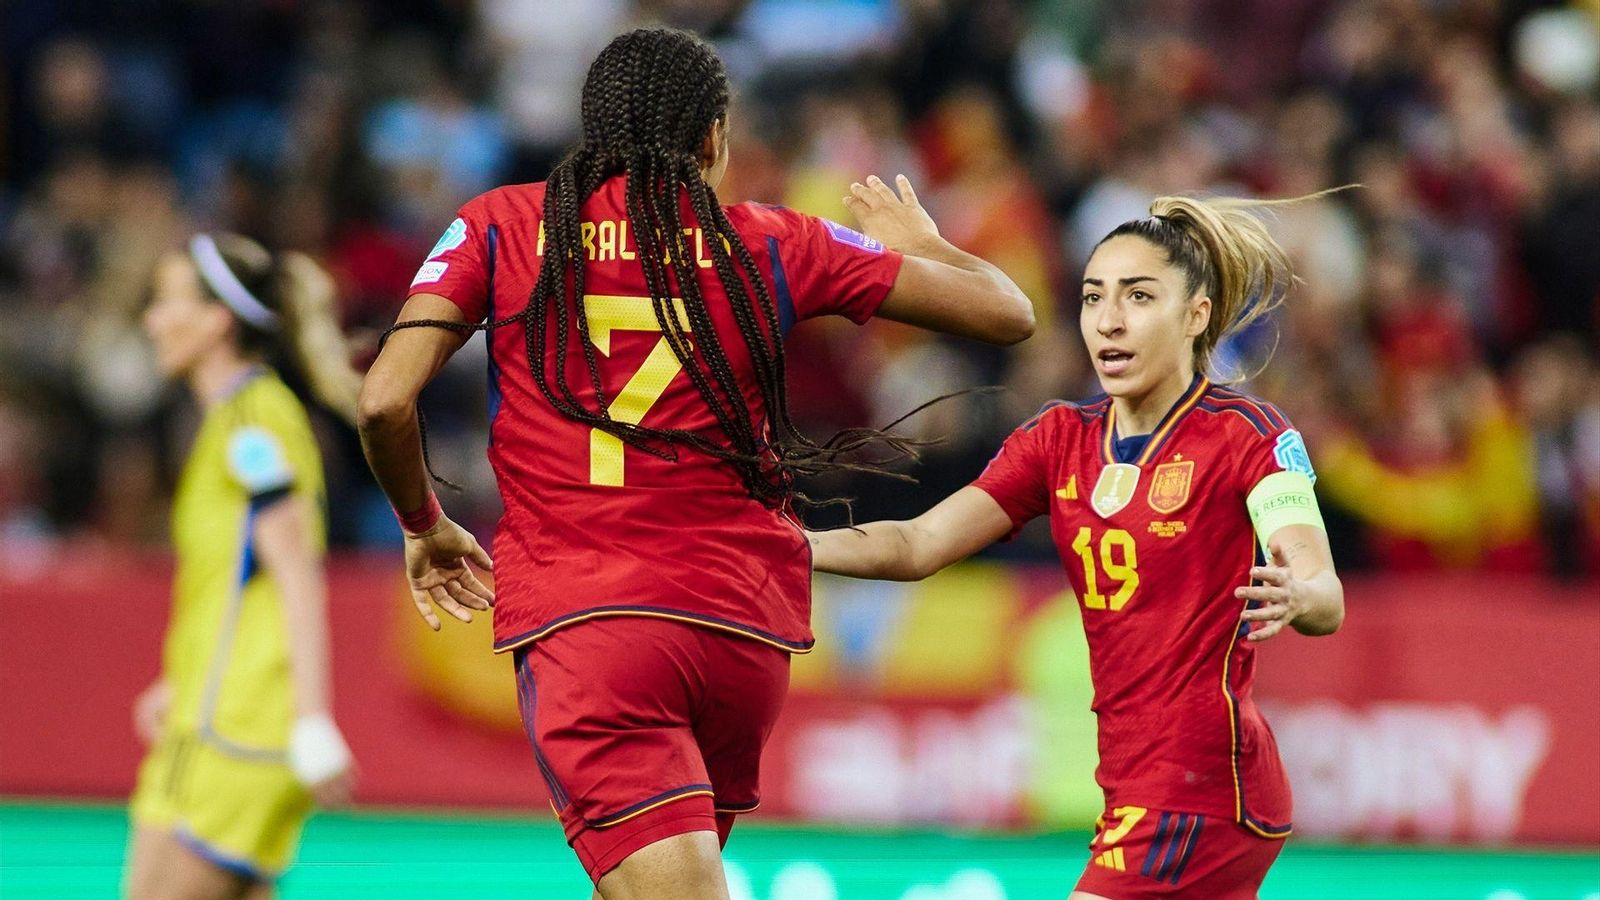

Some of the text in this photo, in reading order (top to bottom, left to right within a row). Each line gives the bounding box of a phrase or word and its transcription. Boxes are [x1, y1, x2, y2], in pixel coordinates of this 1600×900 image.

[577, 294, 694, 487] 7
[1263, 495, 1310, 512] RESPECT
[1072, 527, 1140, 612] 19
